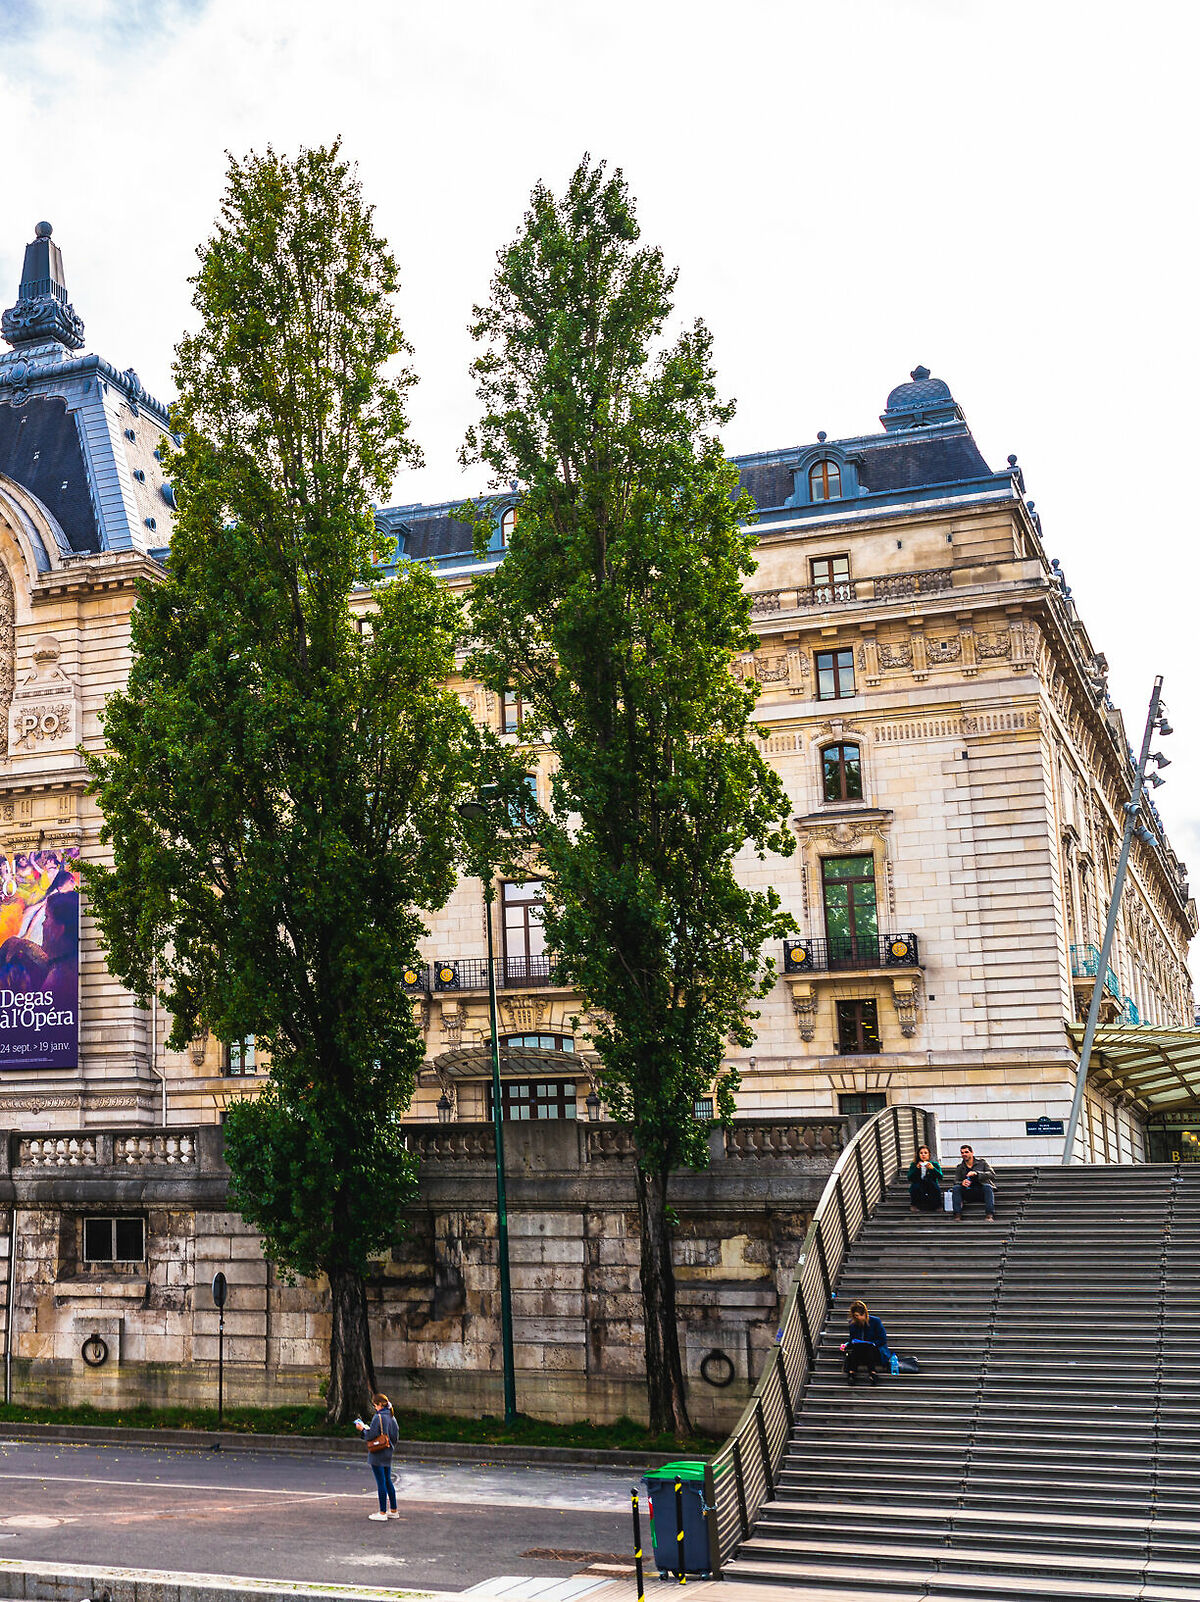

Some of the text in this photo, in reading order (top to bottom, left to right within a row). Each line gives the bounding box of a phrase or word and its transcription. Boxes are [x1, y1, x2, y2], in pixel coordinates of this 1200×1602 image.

[23, 713, 60, 737] PO
[0, 990, 53, 1010] Degas
[0, 1044, 10, 1054] 24
[40, 1042, 49, 1051] 19
[50, 1042, 70, 1053] janv.
